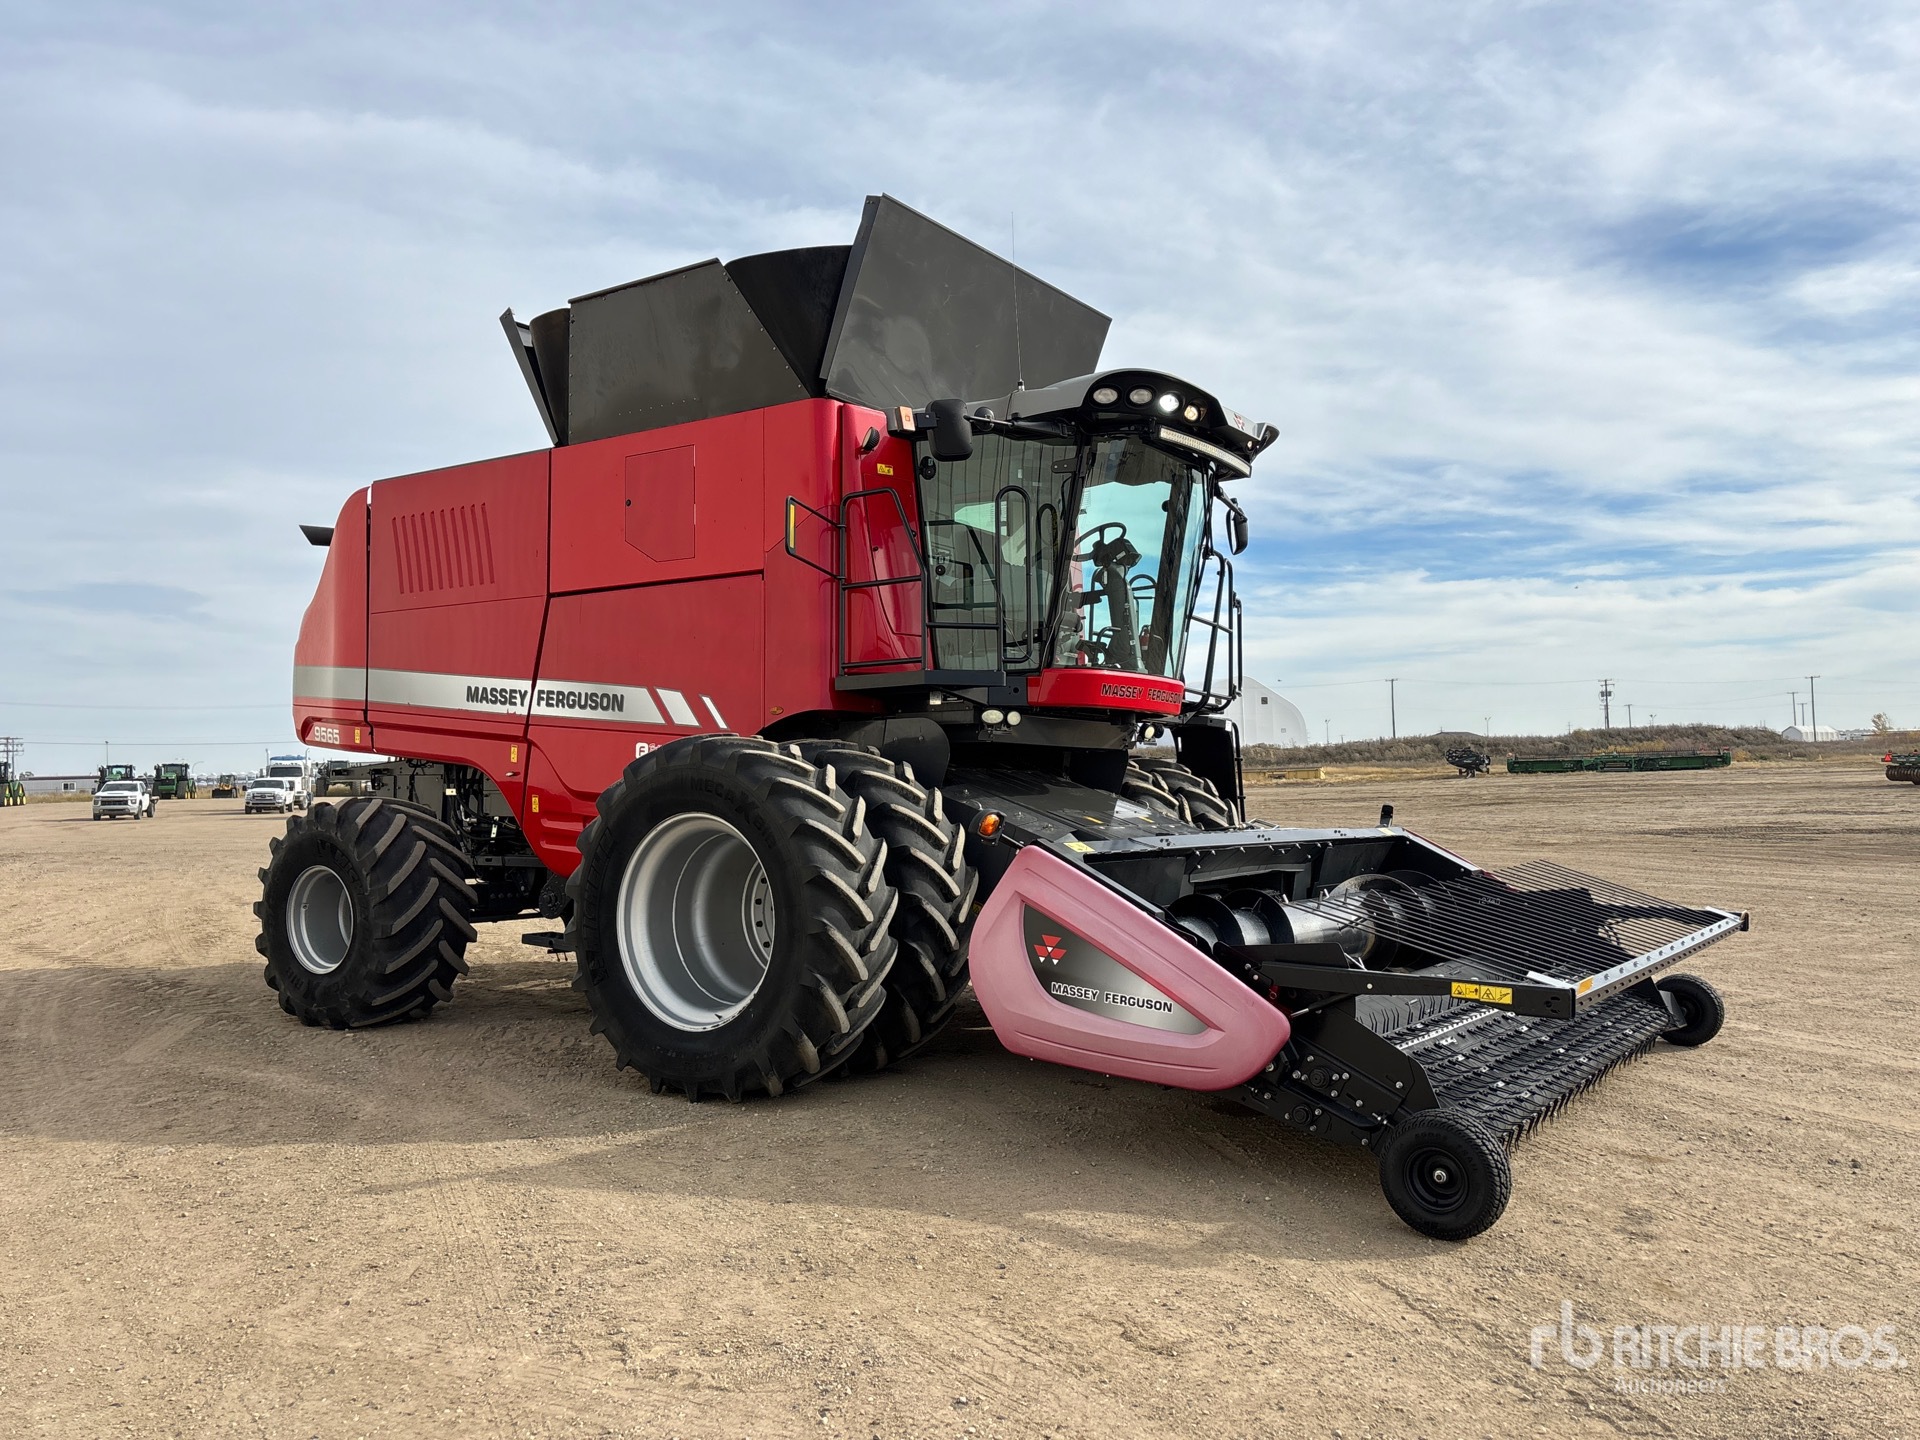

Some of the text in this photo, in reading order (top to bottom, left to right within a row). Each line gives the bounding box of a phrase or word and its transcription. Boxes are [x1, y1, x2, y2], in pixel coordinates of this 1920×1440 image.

[466, 685, 624, 712] MASSEY FERGUSON
[1100, 682, 1182, 705] MASSEY FERGUSON
[314, 726, 340, 745] 9565
[1052, 982, 1173, 1013] MASSEY FERGUSON
